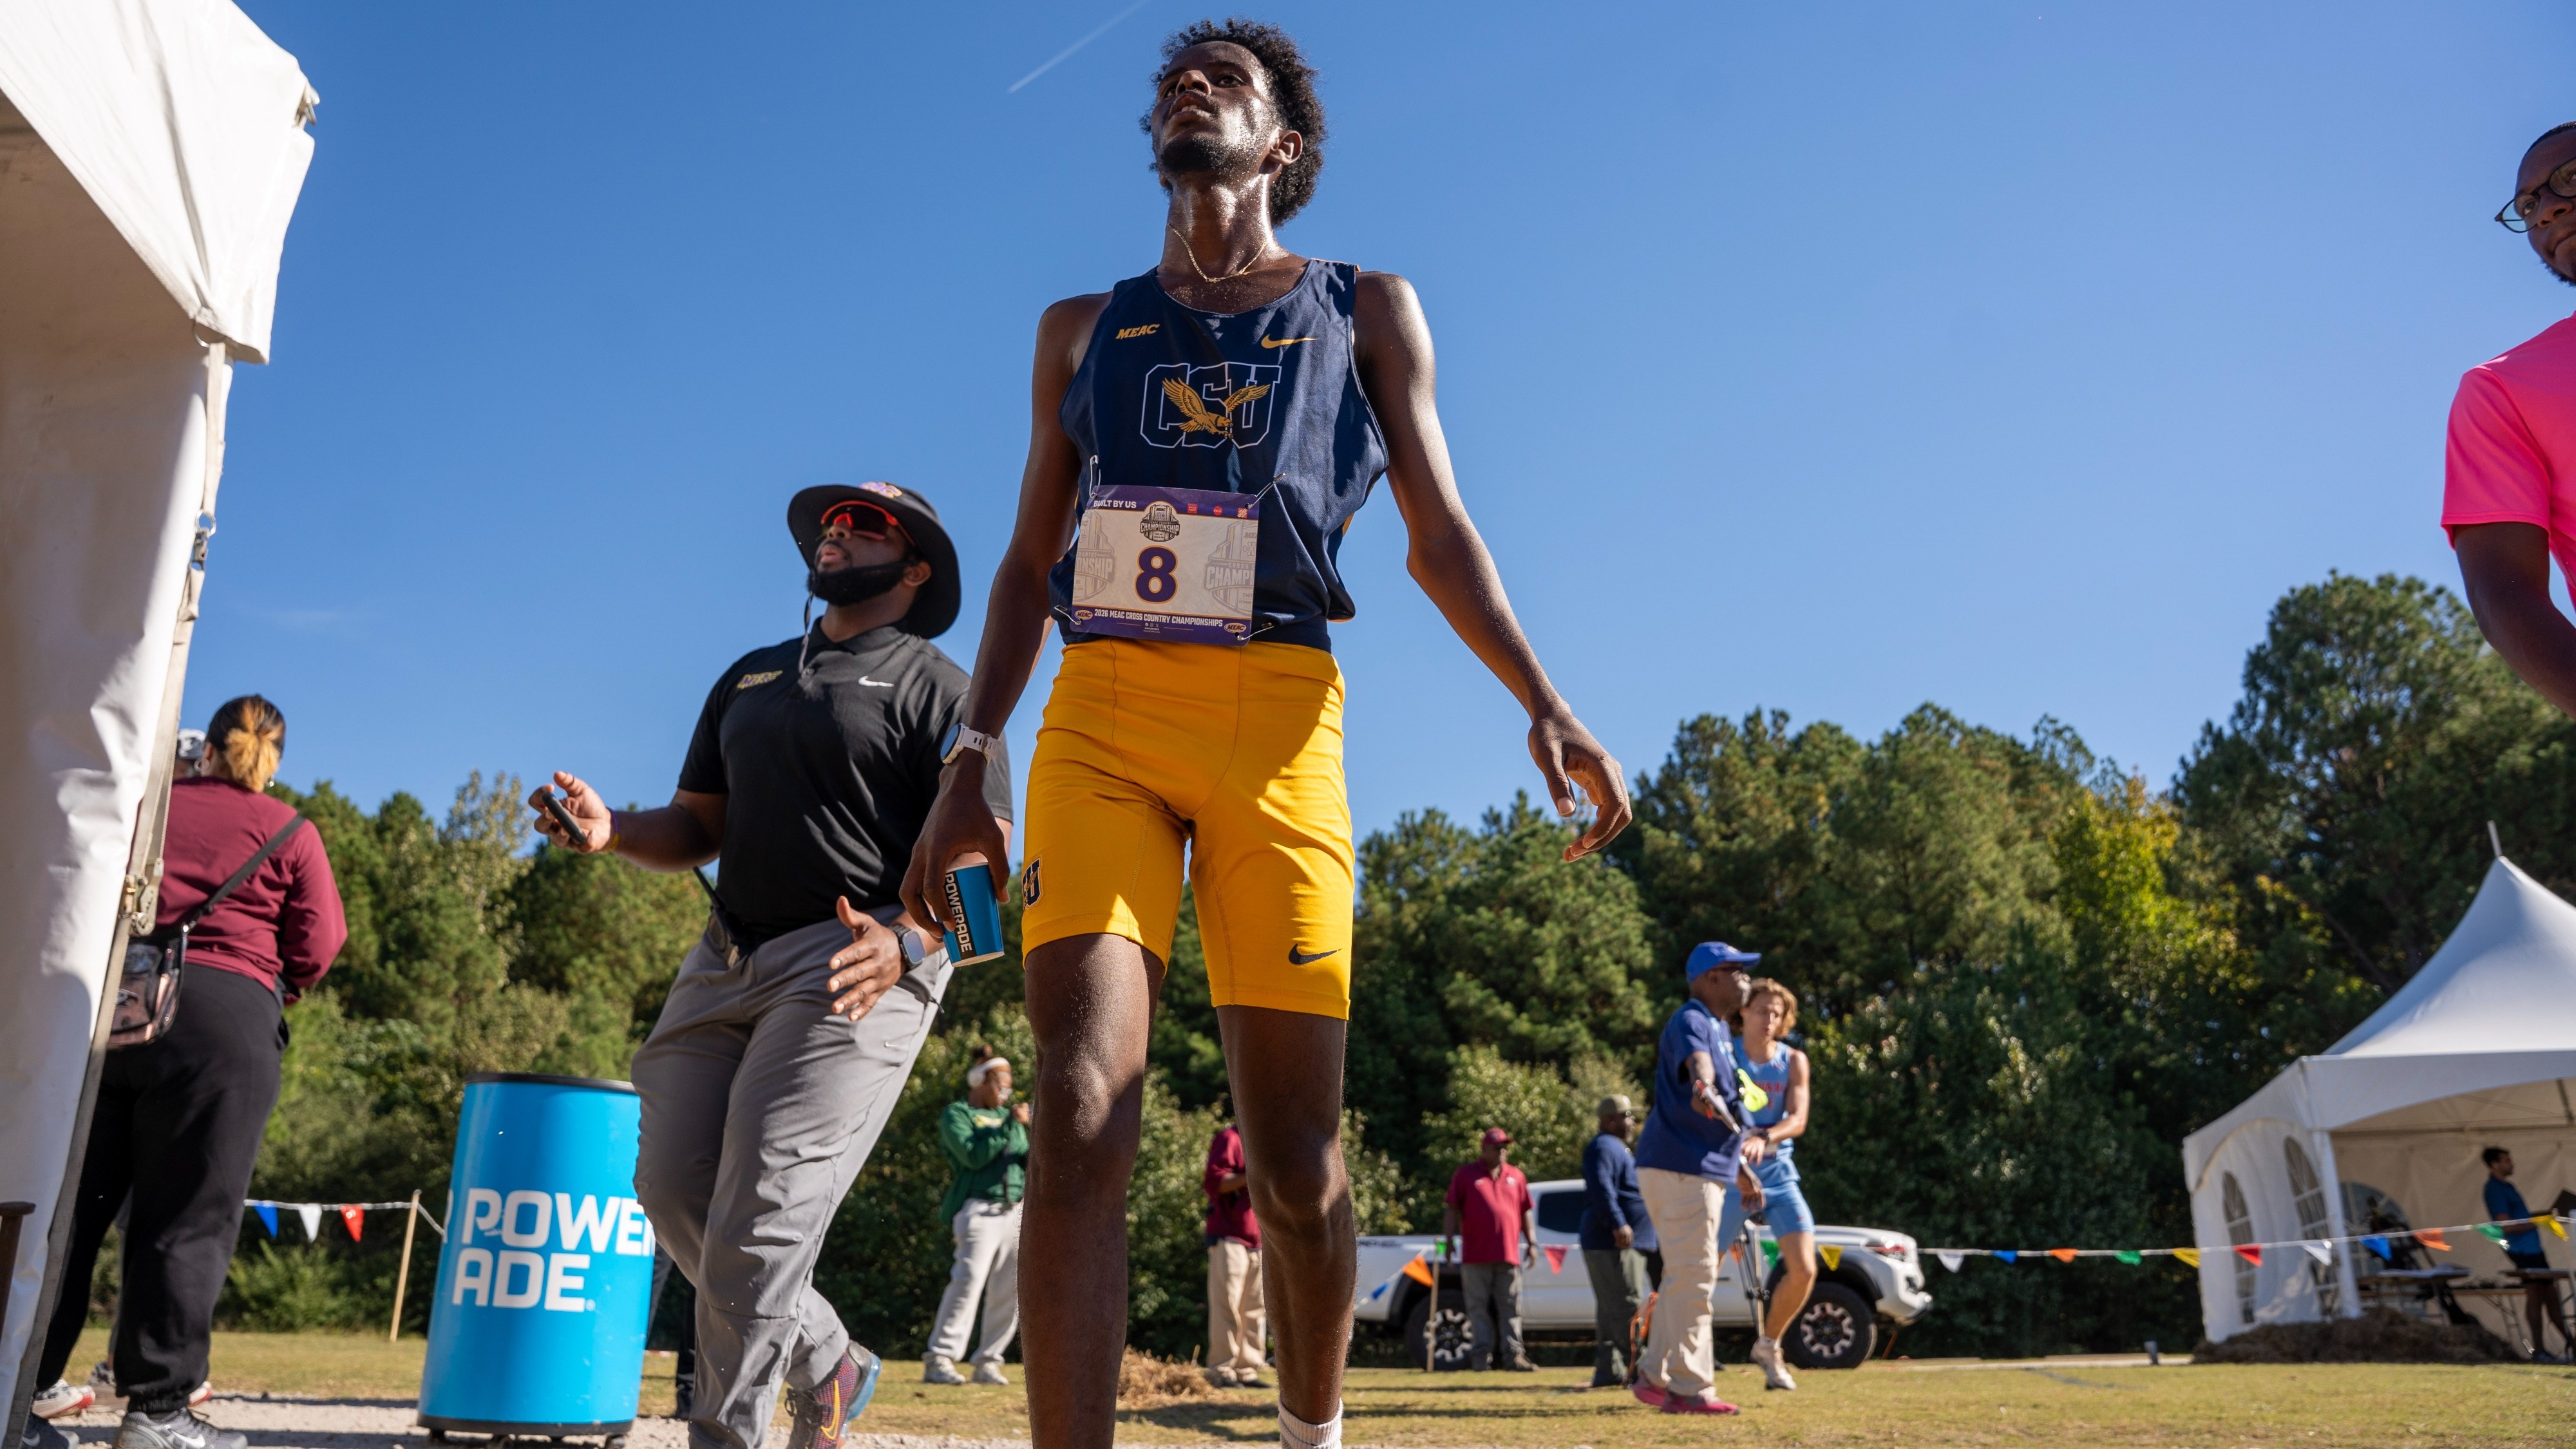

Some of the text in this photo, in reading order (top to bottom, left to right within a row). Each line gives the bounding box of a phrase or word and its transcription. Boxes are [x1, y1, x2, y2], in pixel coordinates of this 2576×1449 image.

[1115, 324, 1160, 339] MEAC
[1140, 362, 1282, 449] CSU
[1141, 522, 1180, 535] CHAMPIONSHIP
[1135, 545, 1178, 604] 8
[1109, 611, 1125, 619] MEAC
[1126, 612, 1143, 621] CROSS
[1144, 614, 1171, 623] COUNTRY
[1171, 616, 1223, 627] CHAMPIONSHIPS
[945, 874, 972, 952] POWERADE
[452, 1248, 591, 1312] ADE
